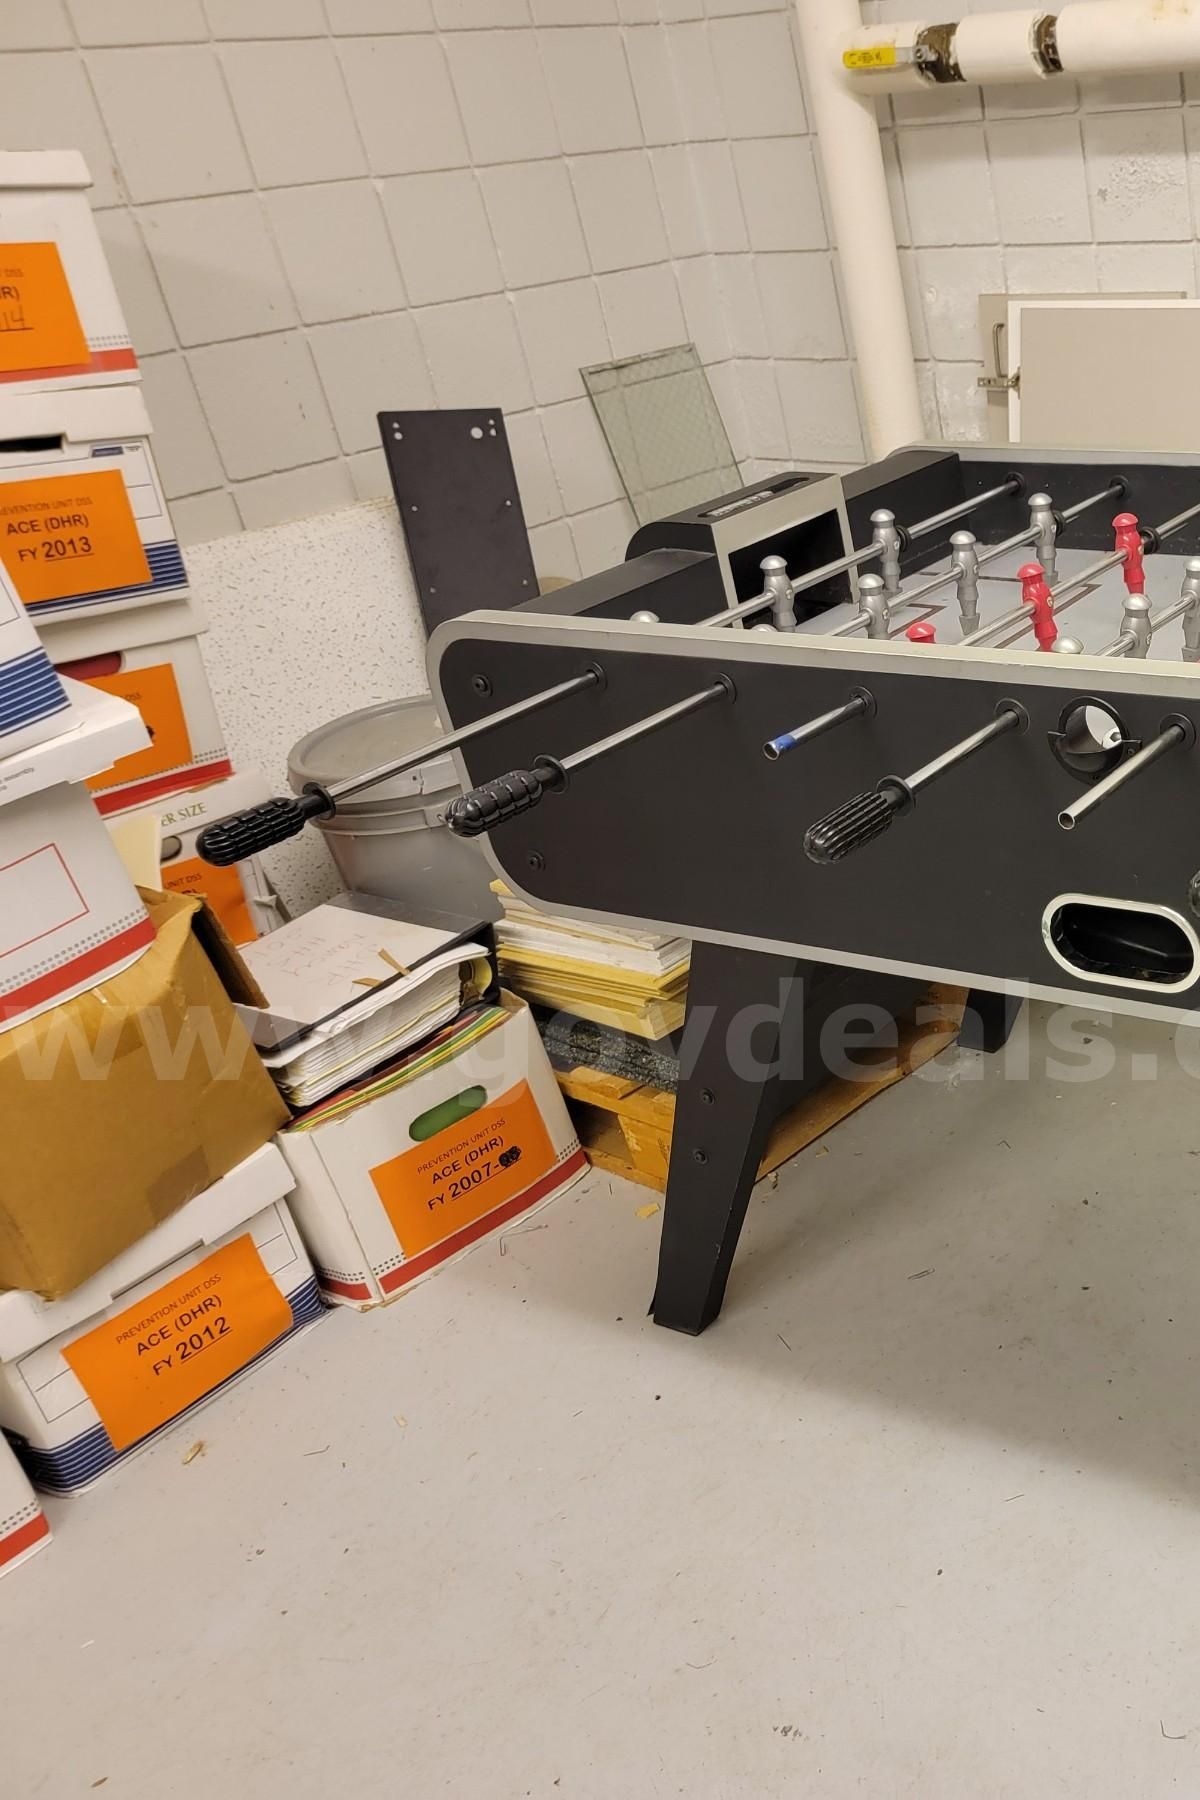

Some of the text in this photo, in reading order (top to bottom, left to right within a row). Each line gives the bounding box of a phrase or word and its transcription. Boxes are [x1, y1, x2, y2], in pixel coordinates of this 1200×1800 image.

[7, 513, 89, 535] ACE (DHR)
[18, 536, 92, 561] FY 2013
[177, 802, 207, 821] SIZE
[417, 1117, 506, 1174] PREVENTION UNIT DSS
[432, 1135, 504, 1184] ACE (DHR)
[427, 1193, 446, 1210] FY
[116, 1274, 222, 1344] PREVENTION UNIT DSS
[137, 1294, 222, 1355] ACE (DHR)
[153, 1316, 231, 1376] FY 2012
